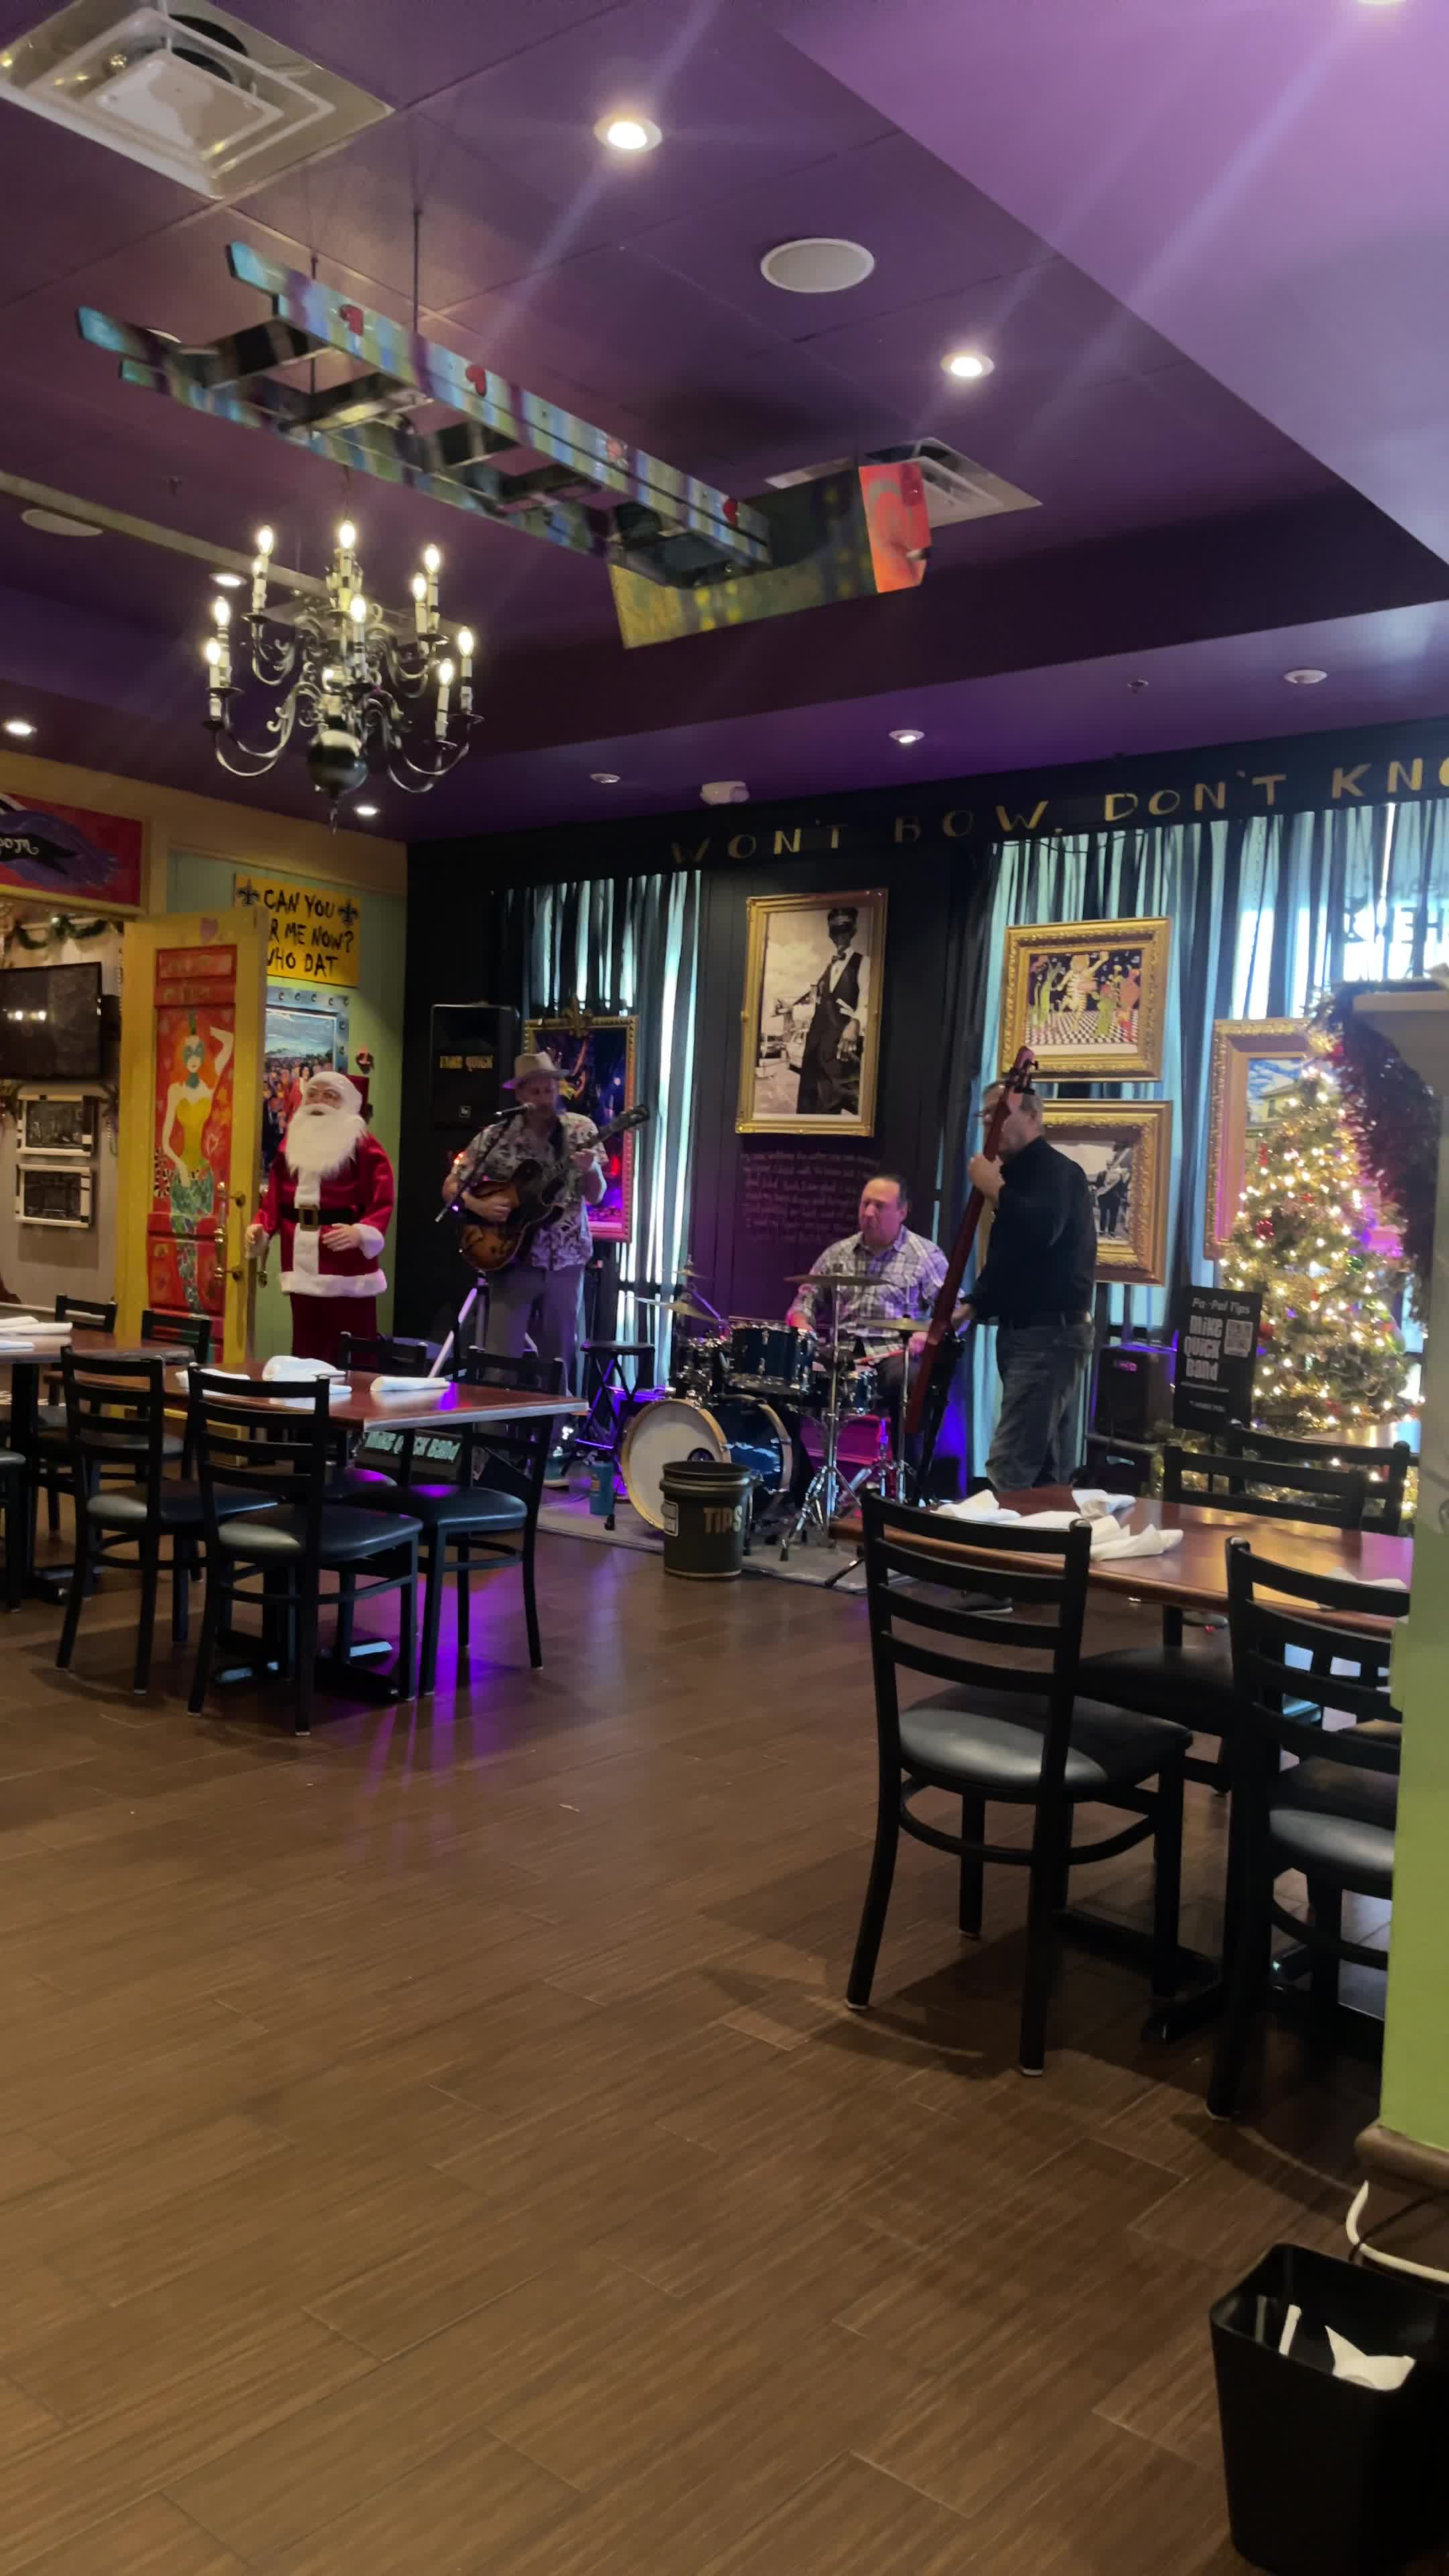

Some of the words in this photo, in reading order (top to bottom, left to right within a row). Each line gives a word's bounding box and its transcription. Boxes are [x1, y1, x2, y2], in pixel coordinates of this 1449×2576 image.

[672, 819, 848, 864] WON'T
[1105, 770, 1287, 821] DON'T
[264, 889, 300, 913] CAN
[304, 894, 335, 918] YOU
[284, 922, 307, 945] ME
[311, 926, 354, 953] NOW?
[305, 953, 338, 977] DAT
